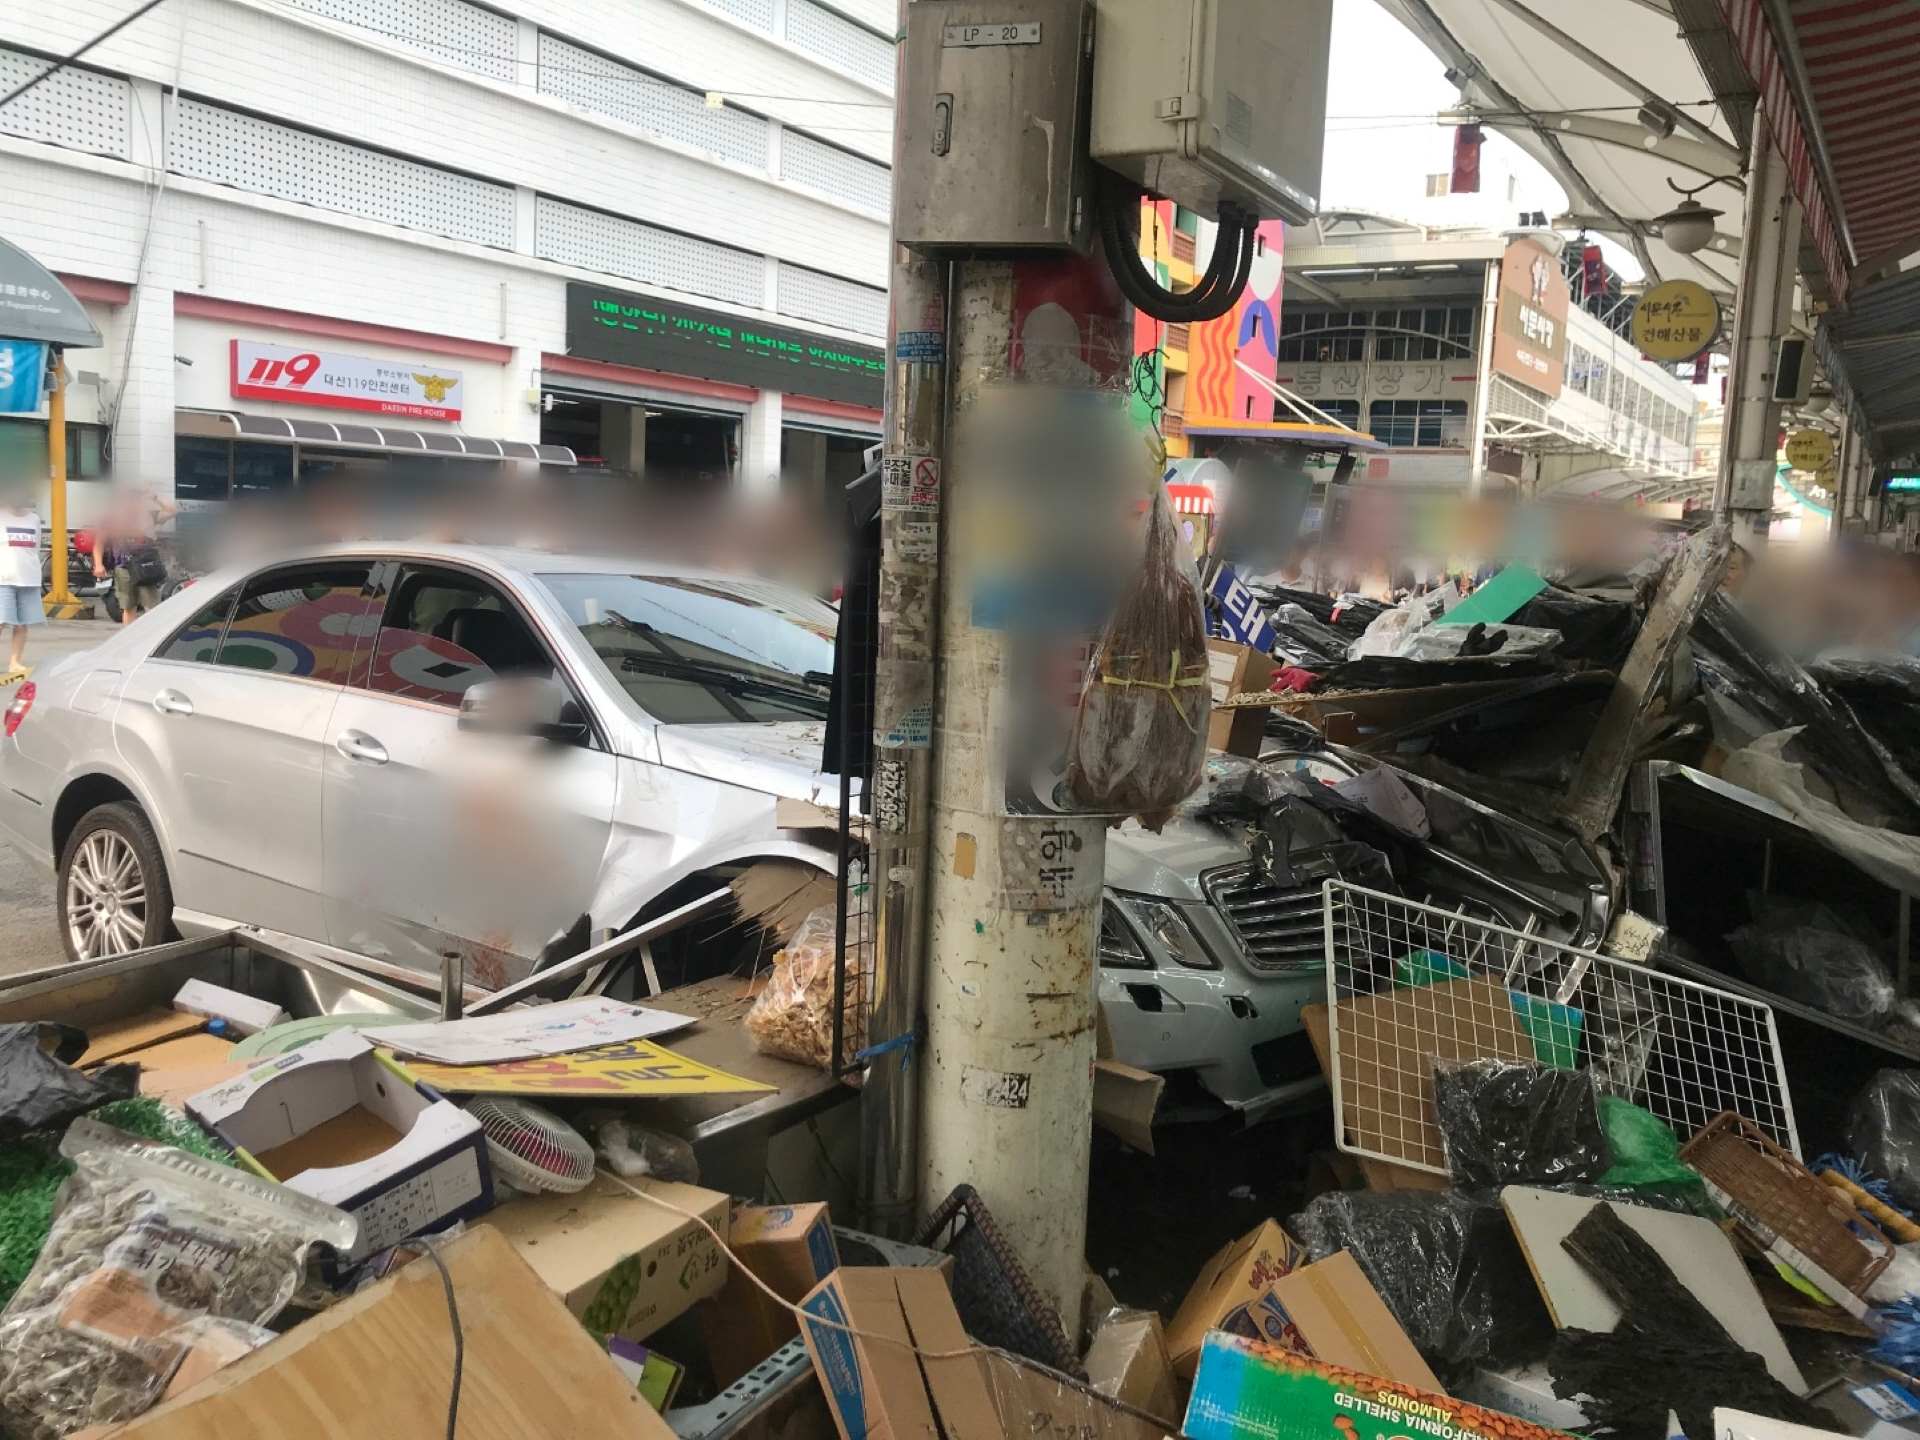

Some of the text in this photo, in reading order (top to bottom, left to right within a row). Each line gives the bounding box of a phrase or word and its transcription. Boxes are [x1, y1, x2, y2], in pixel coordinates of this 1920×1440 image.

[963, 28, 980, 42] LP
[1001, 26, 1018, 41] 20
[1641, 327, 1700, 342] 건해산물
[247, 353, 320, 388] 119
[1297, 364, 1446, 396] 동산상가
[324, 373, 410, 395] 대신119안전센터
[408, 405, 423, 415] FIRE
[1333, 1392, 1401, 1423] SHELLED
[1377, 1391, 1453, 1424] ALMONDS
